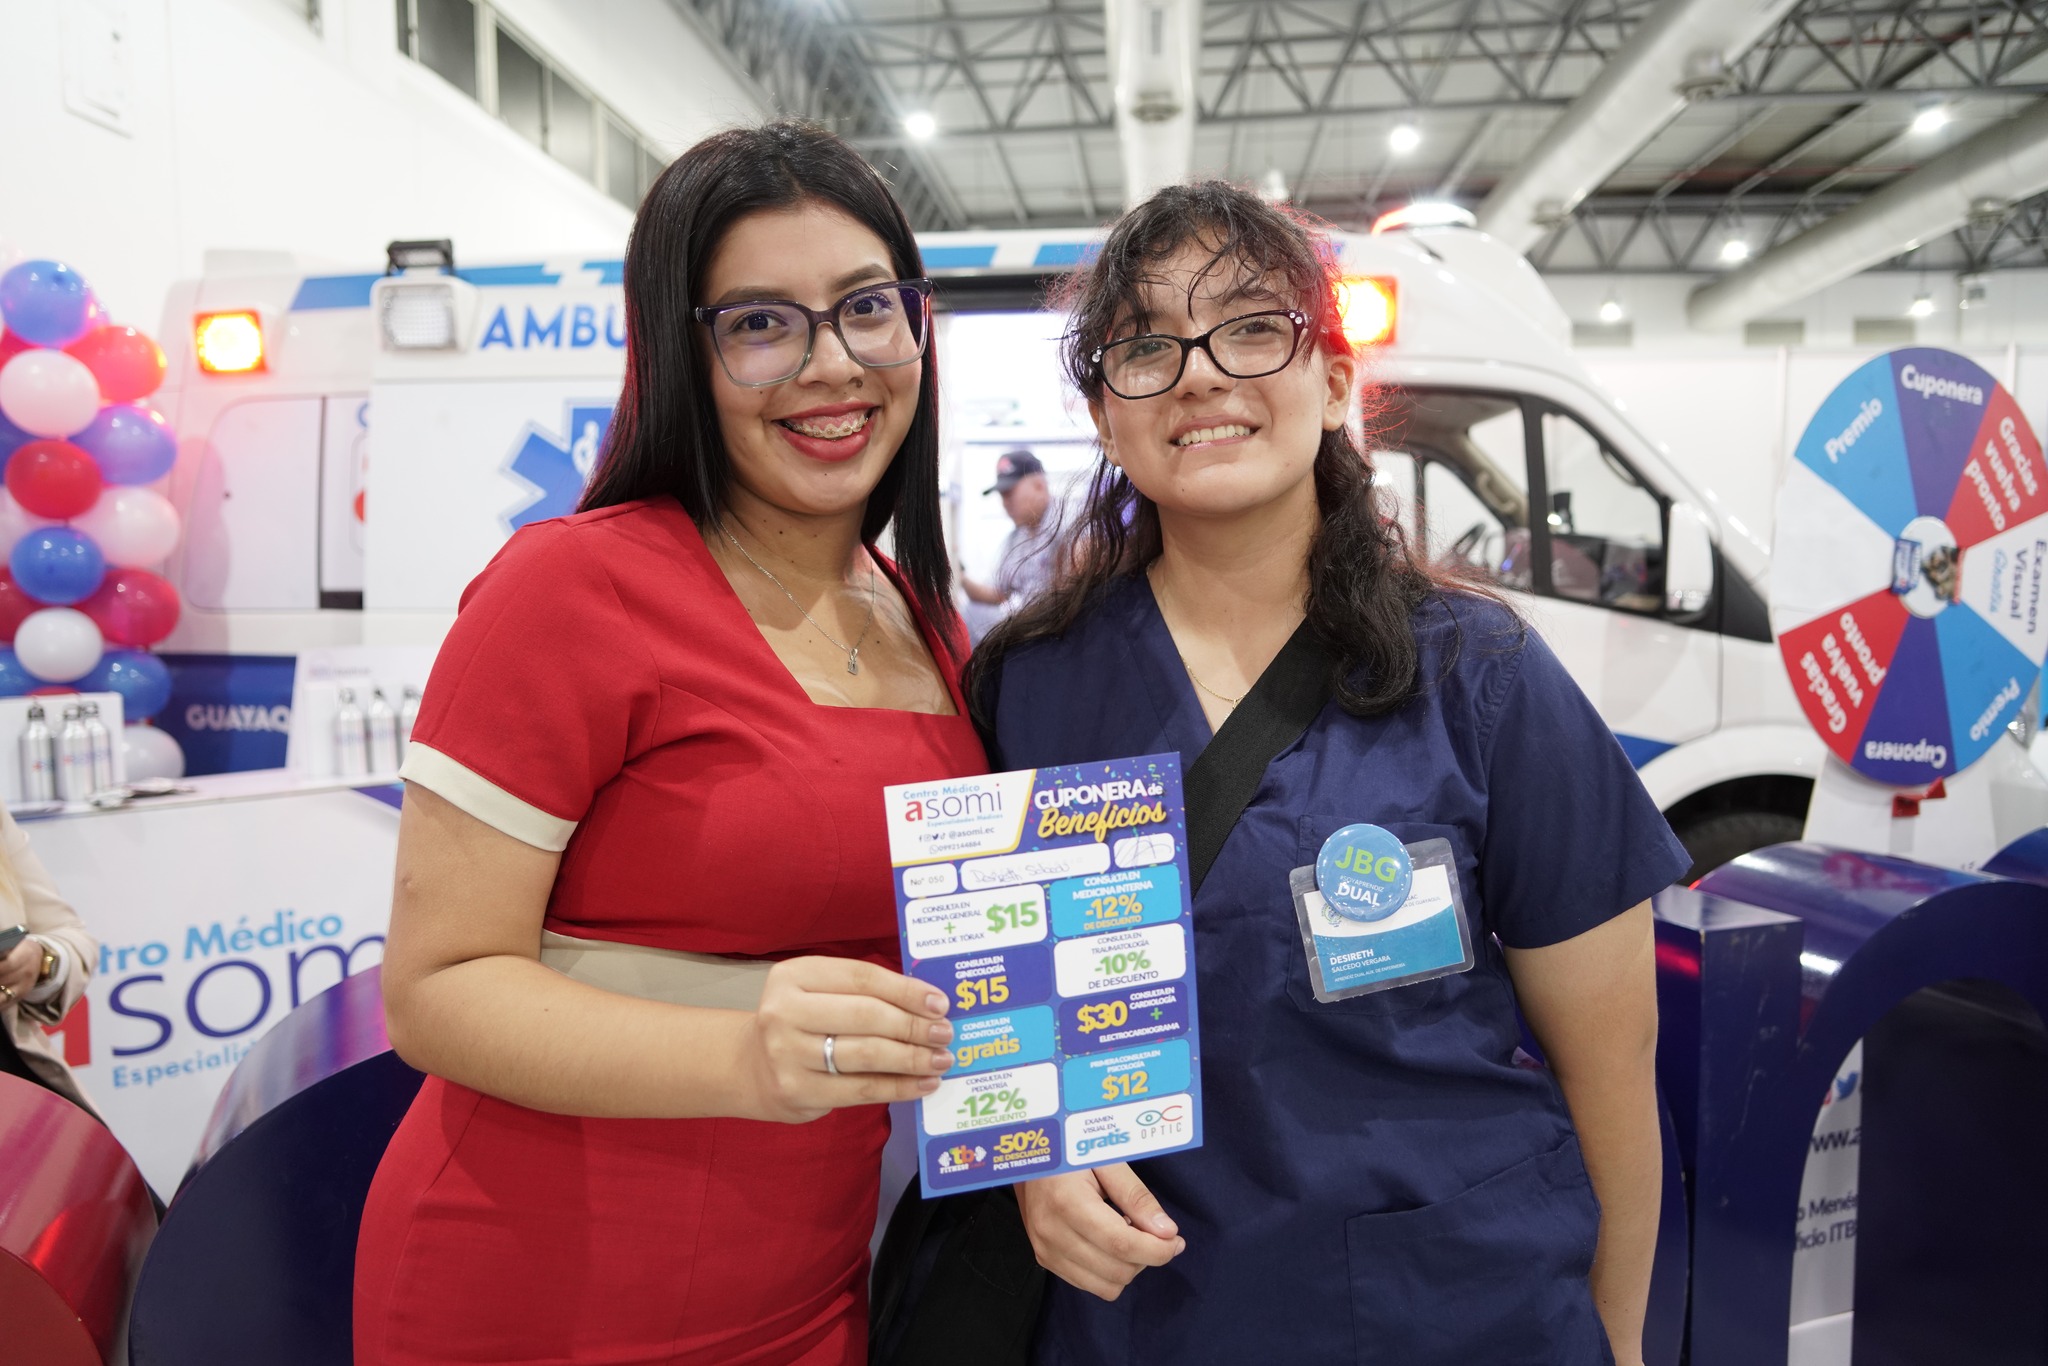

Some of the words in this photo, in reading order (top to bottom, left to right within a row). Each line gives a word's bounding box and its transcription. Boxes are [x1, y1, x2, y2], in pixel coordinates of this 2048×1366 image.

[480, 303, 625, 348] AMBU
[1900, 363, 1983, 406] Cuponera
[1824, 398, 1883, 464] Premio
[1999, 416, 2038, 496] Gracias
[1985, 438, 2020, 513] vuelva
[1965, 458, 2005, 531] pronto
[2010, 548, 2027, 619] Visual
[2027, 540, 2047, 634] Examen
[1840, 612, 1886, 686] pronto
[1822, 632, 1863, 708] vuelva
[1800, 651, 1847, 733] Gracias
[1970, 677, 2020, 741] Premio
[1865, 739, 1947, 769] Cuponera
[903, 789, 938, 799] Centro
[942, 784, 980, 795] Médico
[1034, 779, 1148, 810] CUPONERA
[1147, 782, 1164, 796] de
[905, 783, 1002, 822] asomi
[1037, 800, 1167, 843] Beneficios
[948, 827, 995, 840] @asomi.ec
[1335, 845, 1397, 883] JBG
[928, 875, 945, 884] 050
[1083, 873, 1129, 887] CONSULTA
[1128, 870, 1140, 880] EN
[1072, 885, 1116, 900] MEDICINA
[1115, 880, 1153, 894] INTERNA
[1336, 881, 1380, 906] DUAL
[922, 903, 960, 914] CONSULTA
[960, 901, 971, 909] EN
[1085, 893, 1143, 919] -12%
[912, 914, 949, 925] MEDICINA
[949, 910, 982, 920] GENERAL
[986, 901, 1040, 934] $15
[1083, 922, 1096, 931] DE
[1096, 915, 1142, 929] DESCUENTO
[97, 940, 169, 975] tro
[183, 910, 343, 961] Médico
[948, 936, 958, 944] DE
[1091, 940, 1150, 955] TRAUMATOLOGÍA
[1097, 934, 1132, 945] CONSULTA
[955, 958, 993, 970] CONSULTA
[992, 955, 1004, 965] EN
[1094, 950, 1151, 975] -10%
[1329, 948, 1374, 966] DESIRETH
[1331, 961, 1361, 973] SALCEDO
[1361, 955, 1391, 967] VERGARA
[955, 965, 1006, 979] GINECOLOGÍA
[1088, 981, 1101, 990] DE
[1103, 970, 1159, 987] DESCUENTO
[955, 975, 1010, 1011] $15
[1130, 989, 1166, 1001] CONSULTA
[1165, 987, 1175, 996] EN
[1130, 996, 1177, 1010] CARDIOLOGÍA
[962, 1019, 1001, 1032] CONSULTA
[1000, 1017, 1011, 1026] EN
[1077, 1000, 1128, 1034] $30
[960, 1026, 1015, 1041] ODONTOLOGÍA
[1099, 1022, 1180, 1043] ELECTROCARDIOGRAMA
[956, 1034, 1020, 1068] gratis
[1090, 1057, 1120, 1068] PRIMERA
[1119, 1052, 1151, 1064] CONSULTA
[1150, 1050, 1161, 1058] EN
[112, 1041, 256, 1088] Especiali
[1107, 1061, 1145, 1073] PSICOLOGÍA
[965, 1074, 1002, 1085] CONSULTA
[1002, 1072, 1013, 1080] EN
[971, 1082, 1008, 1093] PEDIATRÍA
[1102, 1070, 1149, 1100] $12
[956, 1088, 1026, 1118] -12%
[957, 1120, 969, 1130] DE
[971, 1110, 1027, 1127] DESCUENTO
[1083, 1125, 1106, 1134] VISUAL
[1085, 1115, 1114, 1126] EXAMEN
[1141, 1122, 1182, 1139] OPTIC
[993, 1128, 1050, 1154] -50%
[1076, 1128, 1130, 1156] gratis
[993, 1155, 1004, 1163] DE
[1004, 1147, 1051, 1161] DESCUENTO
[993, 1161, 1010, 1171] POR
[1009, 1157, 1028, 1168] TRES
[1027, 1155, 1051, 1165] MESES
